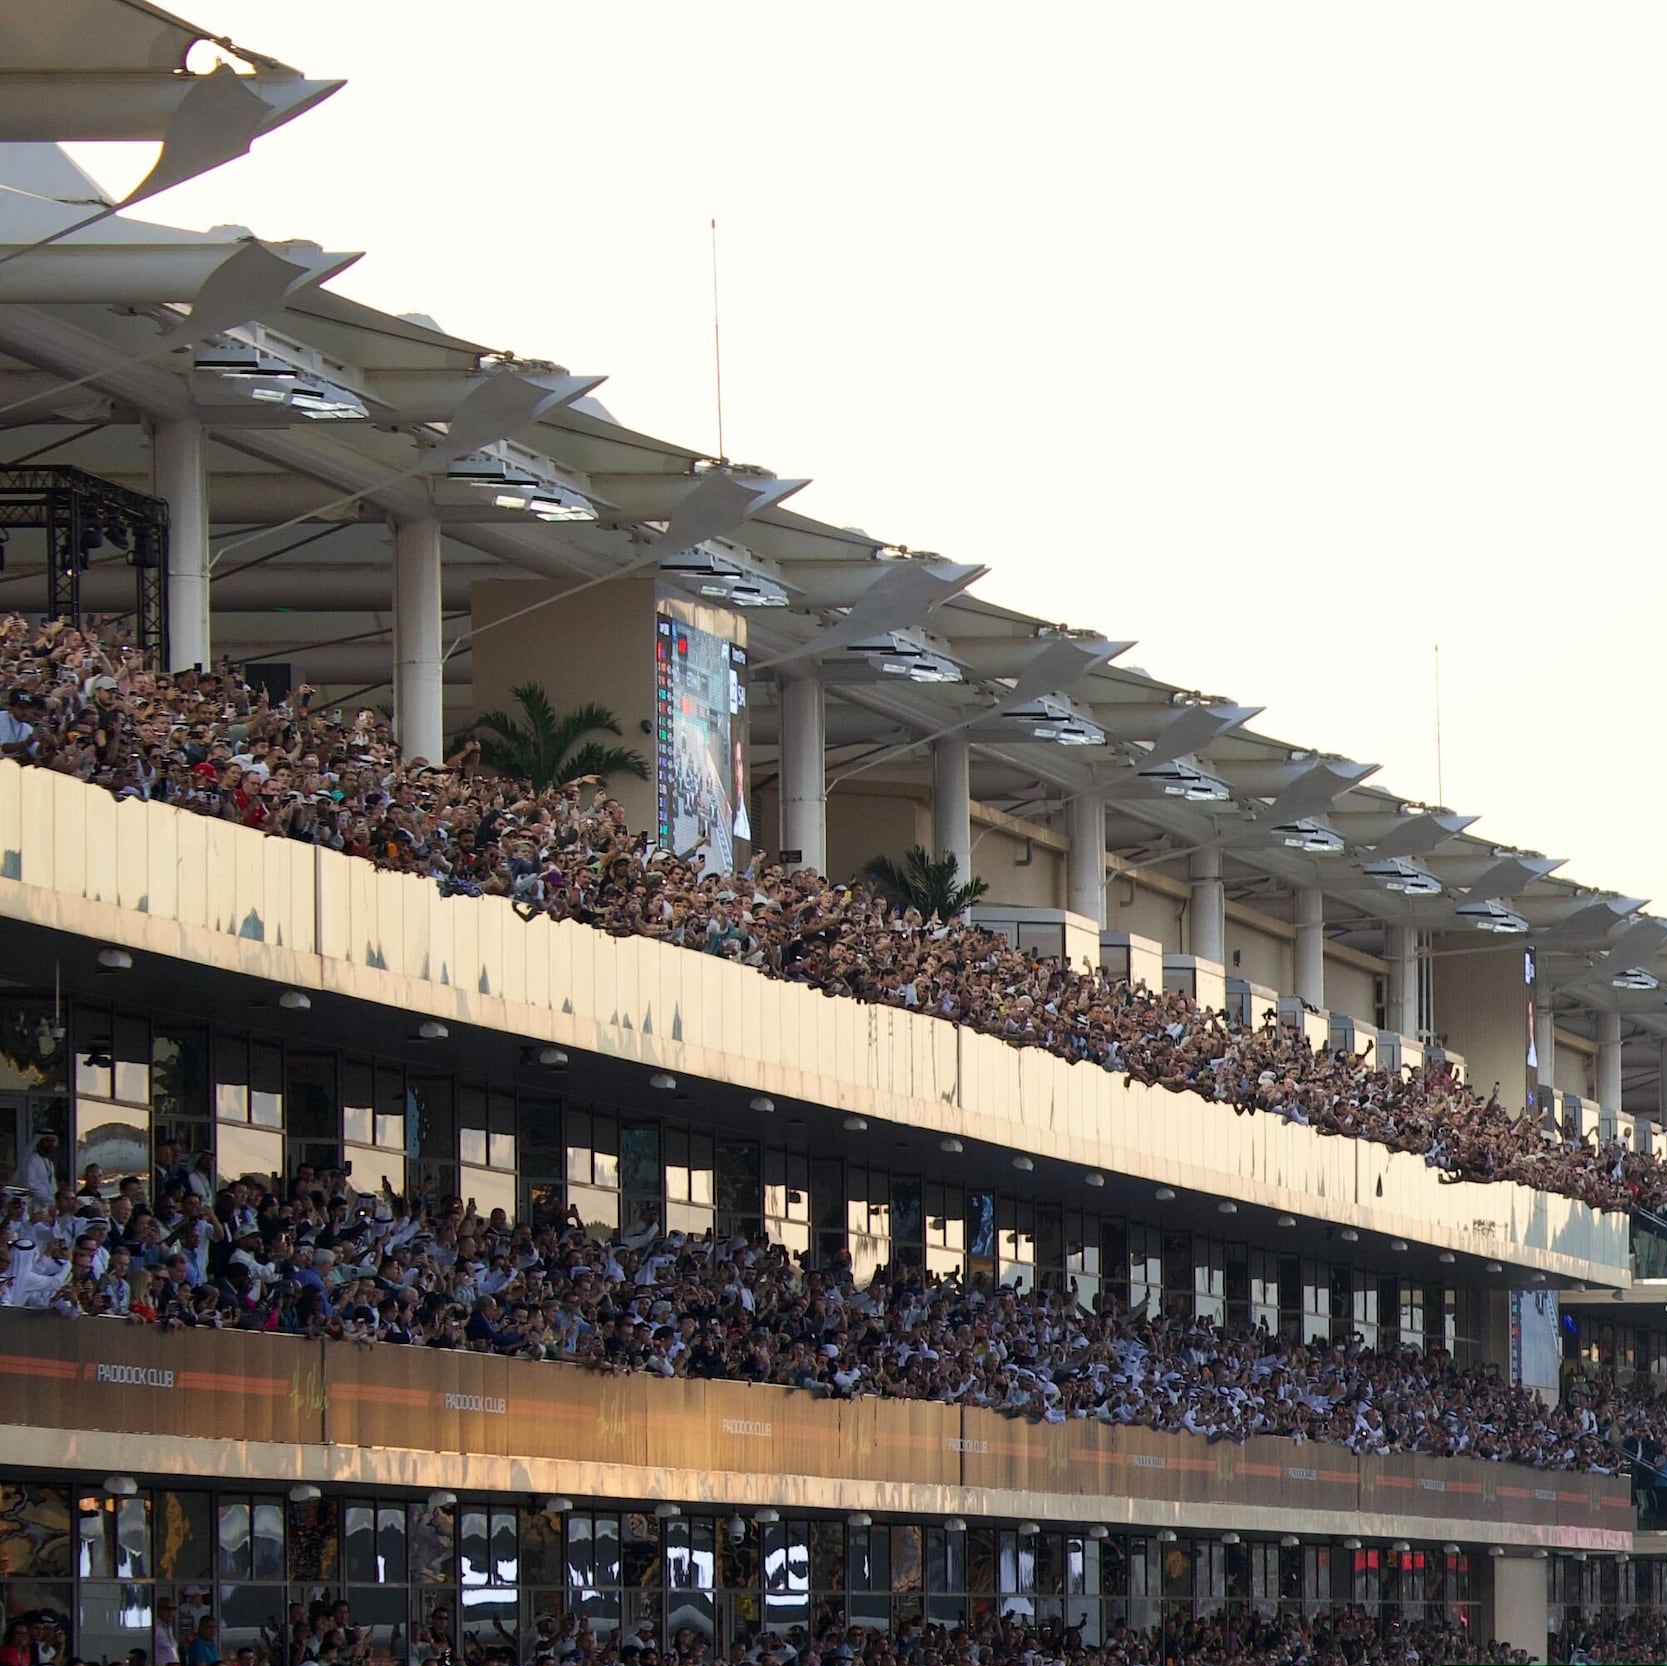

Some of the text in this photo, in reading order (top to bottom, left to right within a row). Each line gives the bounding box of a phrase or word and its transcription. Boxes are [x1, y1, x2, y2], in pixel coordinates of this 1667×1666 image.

[97, 1363, 174, 1389] PADDOCK CLUB
[445, 1392, 506, 1414] PADDOCK CLUB
